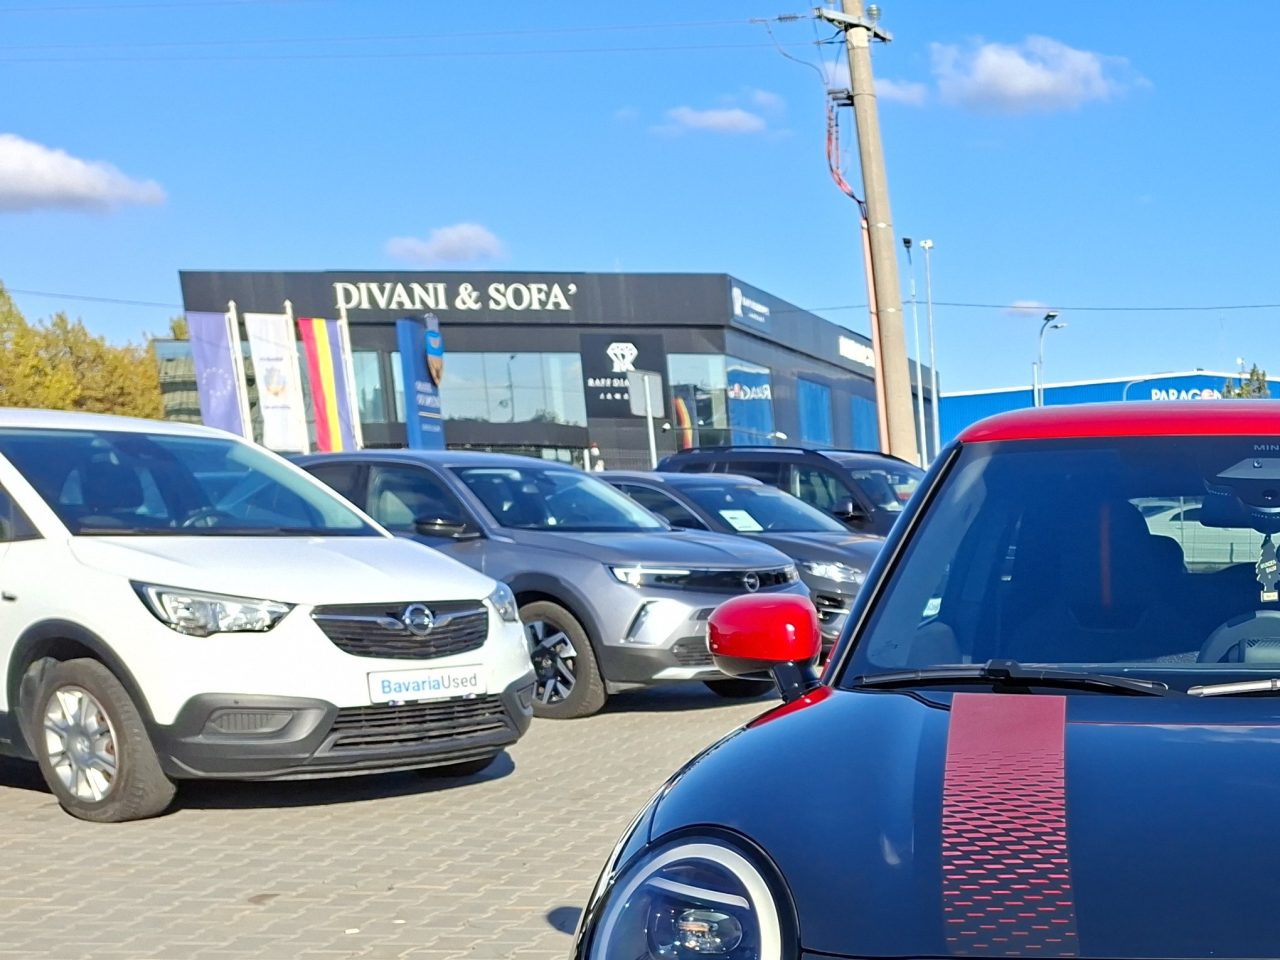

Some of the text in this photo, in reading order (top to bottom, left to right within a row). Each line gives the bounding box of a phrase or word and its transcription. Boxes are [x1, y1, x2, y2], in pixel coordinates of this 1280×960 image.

[333, 282, 448, 310] DIVANI
[455, 282, 482, 310] &
[380, 673, 478, 695] BavariaUsed
